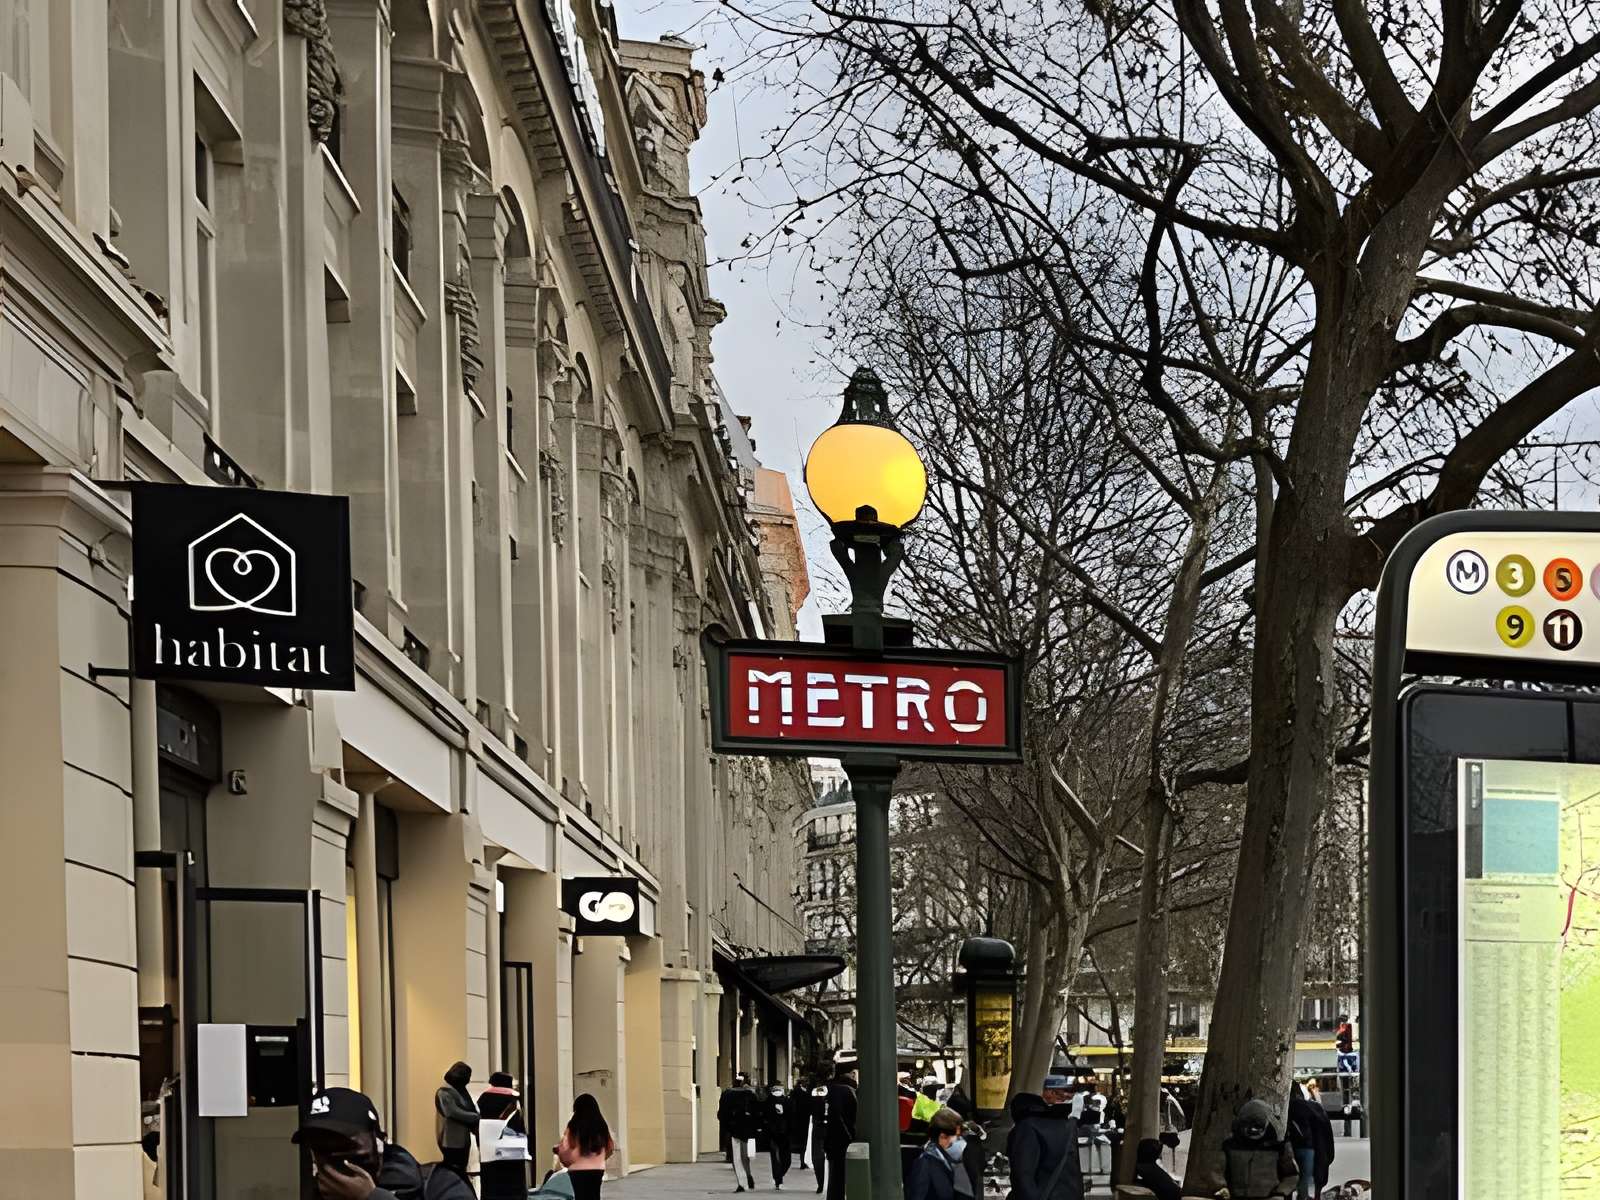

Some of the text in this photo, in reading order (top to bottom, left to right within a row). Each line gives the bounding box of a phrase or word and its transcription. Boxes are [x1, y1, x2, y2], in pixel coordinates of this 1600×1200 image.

[1506, 562, 1524, 590] 3
[1555, 567, 1573, 593] 5
[154, 623, 331, 675] habitat
[1506, 614, 1575, 645] 9 11
[748, 669, 988, 733] METRO
